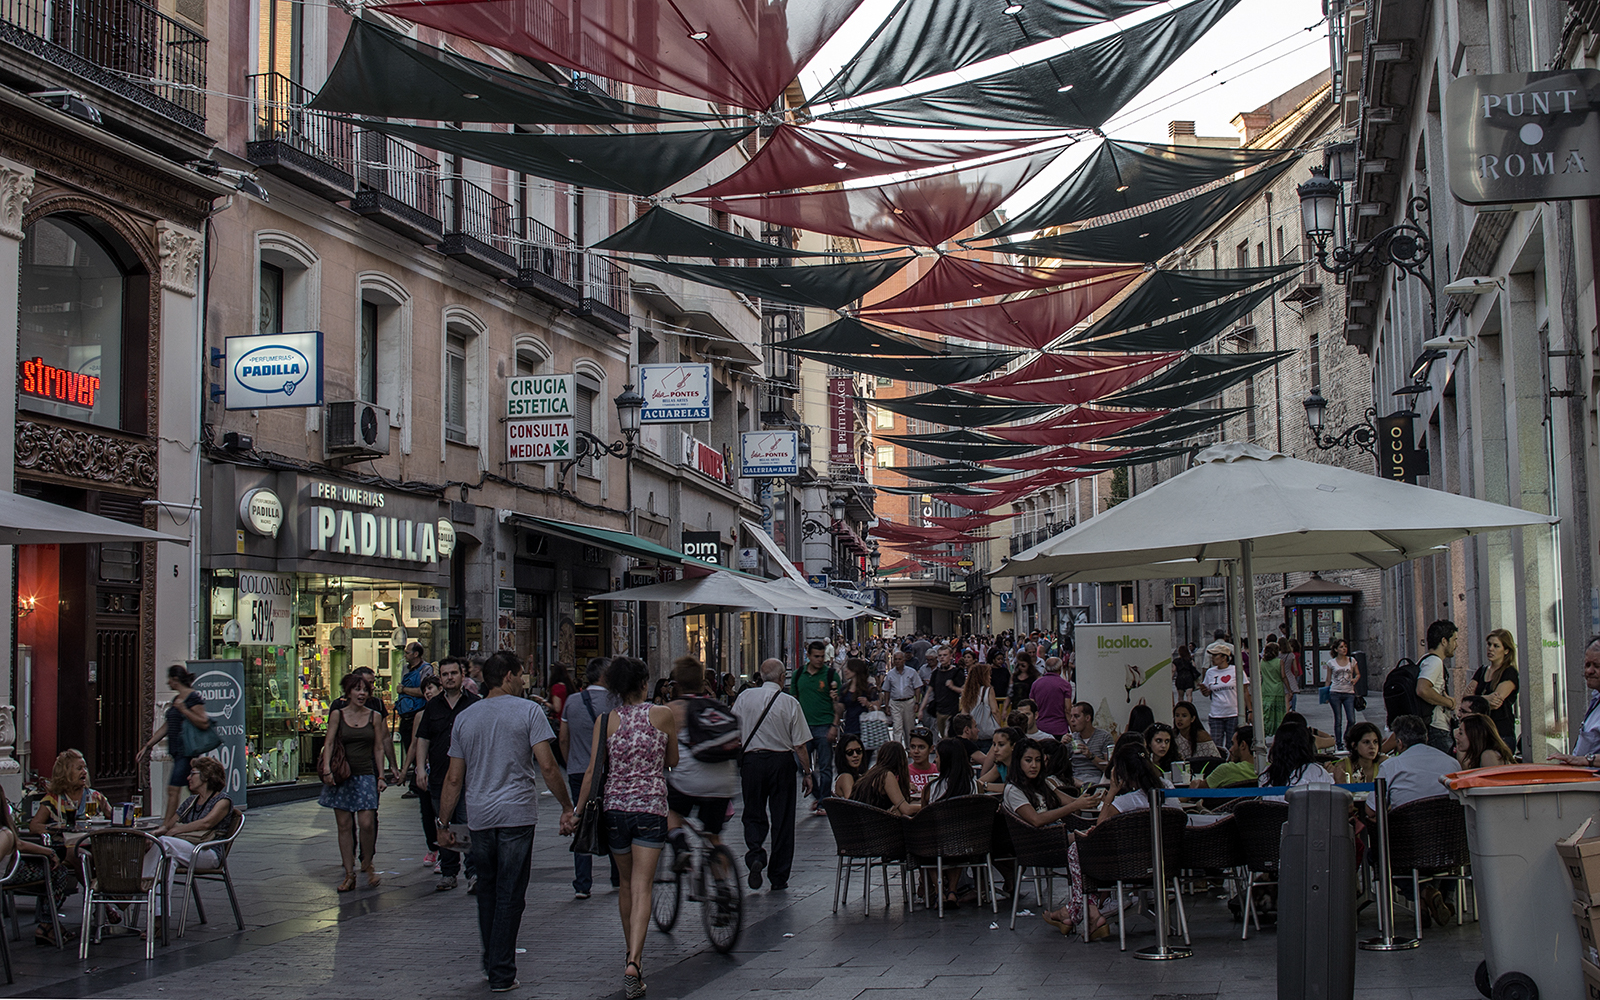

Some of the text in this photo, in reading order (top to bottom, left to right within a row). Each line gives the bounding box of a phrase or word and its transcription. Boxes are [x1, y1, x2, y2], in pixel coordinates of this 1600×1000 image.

[1481, 89, 1577, 118] PUNT
[1479, 149, 1589, 180] ROMA
[251, 354, 292, 363] PERFUMERIAS
[242, 363, 300, 378] PADILLA
[23, 357, 100, 406] strover
[510, 378, 567, 396] CIRUGIA
[670, 390, 700, 398] PONTES
[508, 397, 569, 415] ESTETICA
[643, 408, 707, 419] ACUARELAS
[837, 380, 846, 442] PETIT PALACE
[509, 423, 569, 439] CONSULTA
[509, 443, 552, 459] MEDICA
[1390, 426, 1405, 482] UCCO
[743, 466, 773, 474] GALERIA
[318, 482, 385, 508] PERFUMERIAS
[252, 505, 280, 519] PADILLA
[318, 506, 438, 564] PADILLA
[438, 532, 454, 543] ADILLA
[173, 564, 180, 578] 5
[240, 574, 291, 597] COLONIAS
[251, 599, 275, 643] 50%
[216, 724, 244, 736] ENTOS
